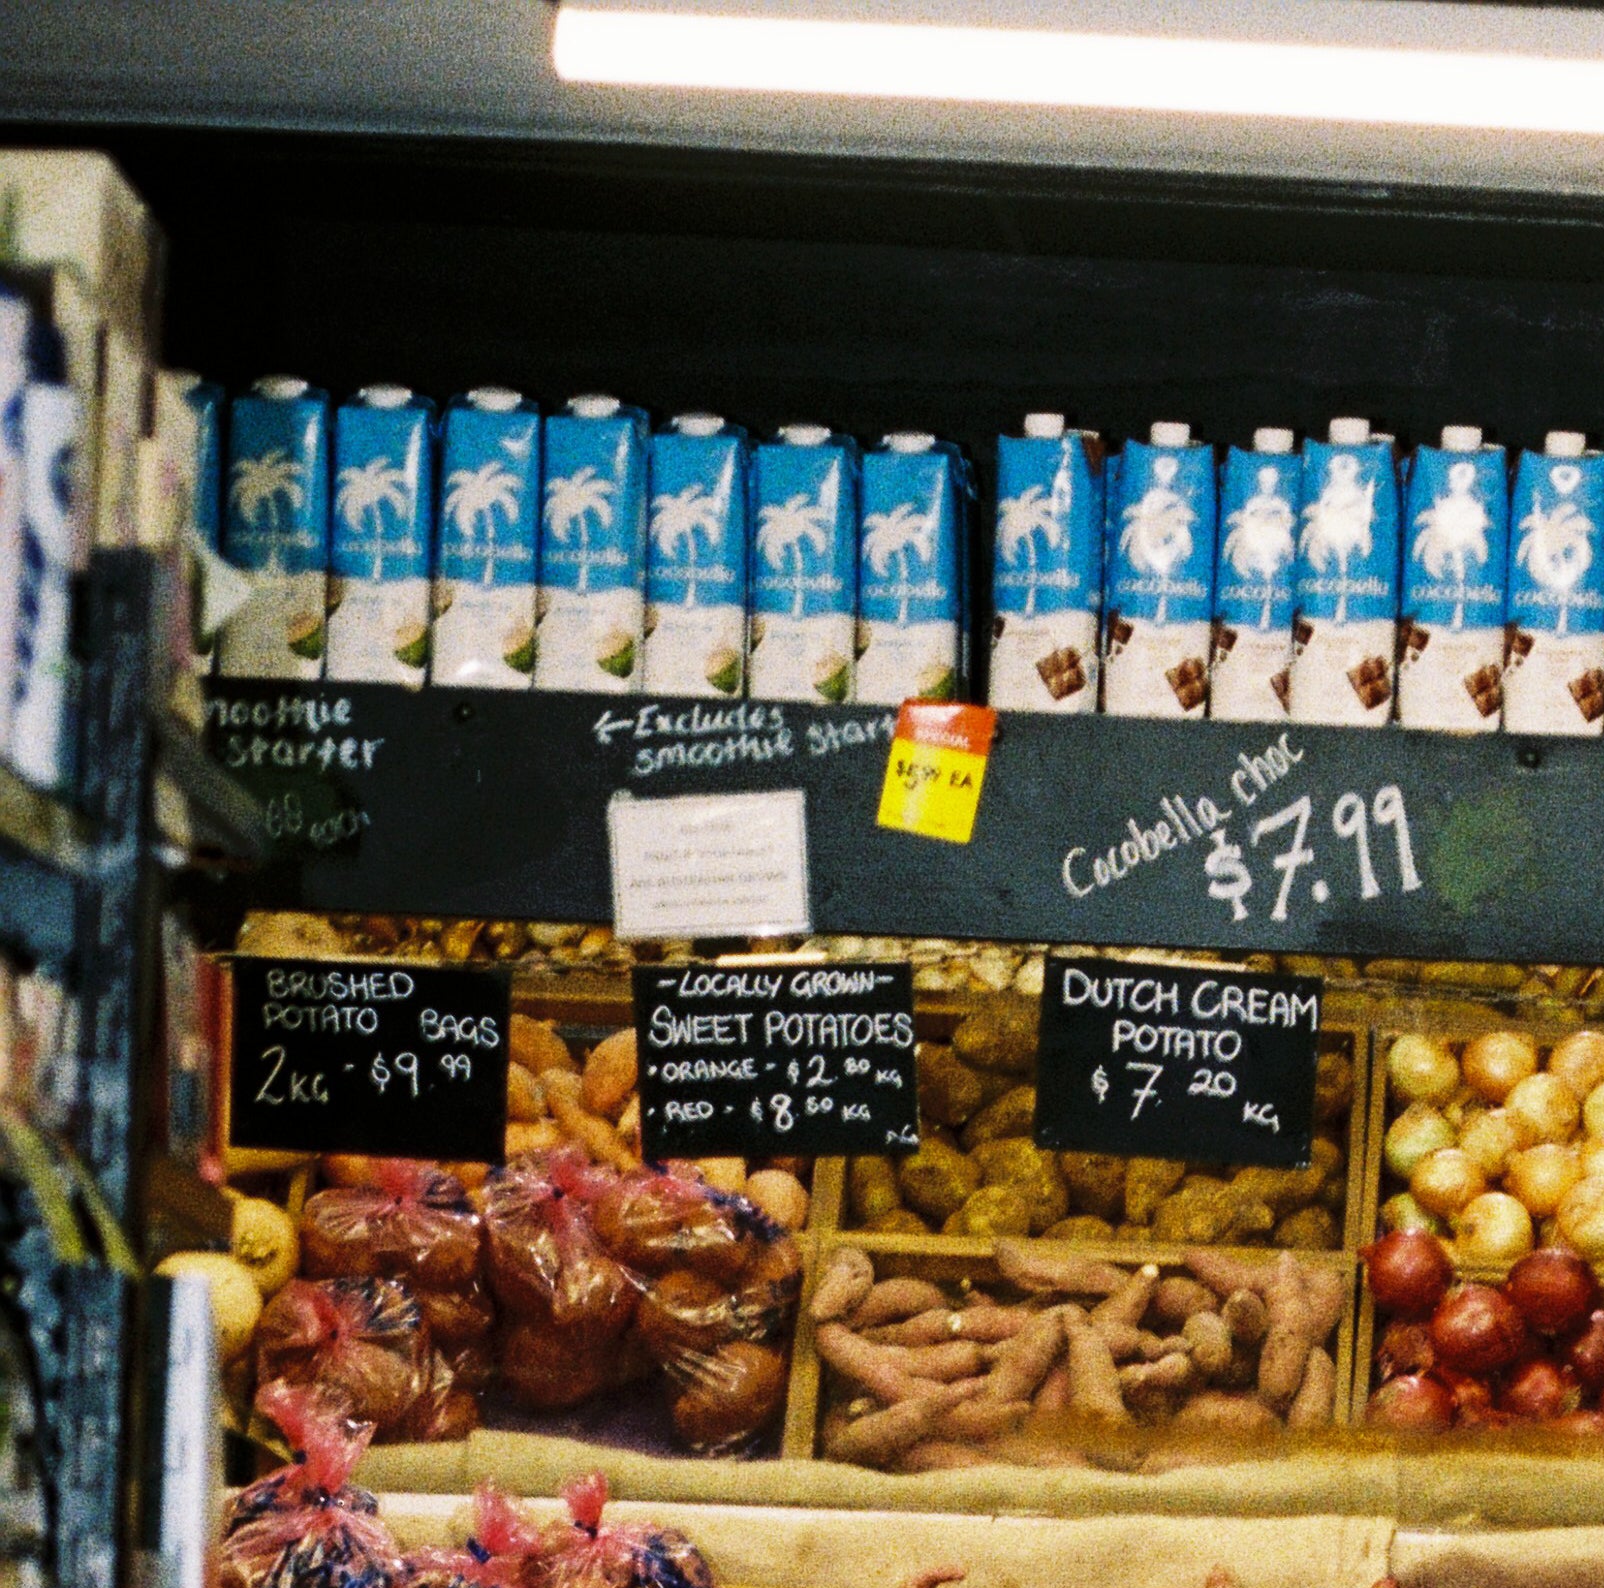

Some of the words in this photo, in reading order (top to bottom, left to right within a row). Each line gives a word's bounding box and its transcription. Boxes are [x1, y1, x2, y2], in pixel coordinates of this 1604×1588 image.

[633, 703, 786, 740] Excludes
[631, 727, 796, 777] smoothie
[1061, 795, 1232, 899] Cocobella
[1231, 732, 1304, 806] choc
[1204, 783, 1422, 922] $7.99
[266, 967, 416, 1001] BRUSHED
[1062, 967, 1179, 1016] DUTCH
[1191, 979, 1319, 1033] CREAM
[263, 1002, 379, 1035] POTATO
[419, 1008, 500, 1048] BAGS
[650, 1004, 753, 1047] SWEET
[764, 1010, 914, 1049] POTATOES
[1111, 1018, 1243, 1063] POTATO
[661, 1057, 759, 1083] ORANGE
[874, 1068, 904, 1090] KG
[664, 1100, 715, 1123] RED
[841, 1103, 872, 1123] KG
[1241, 1100, 1281, 1135] KG
